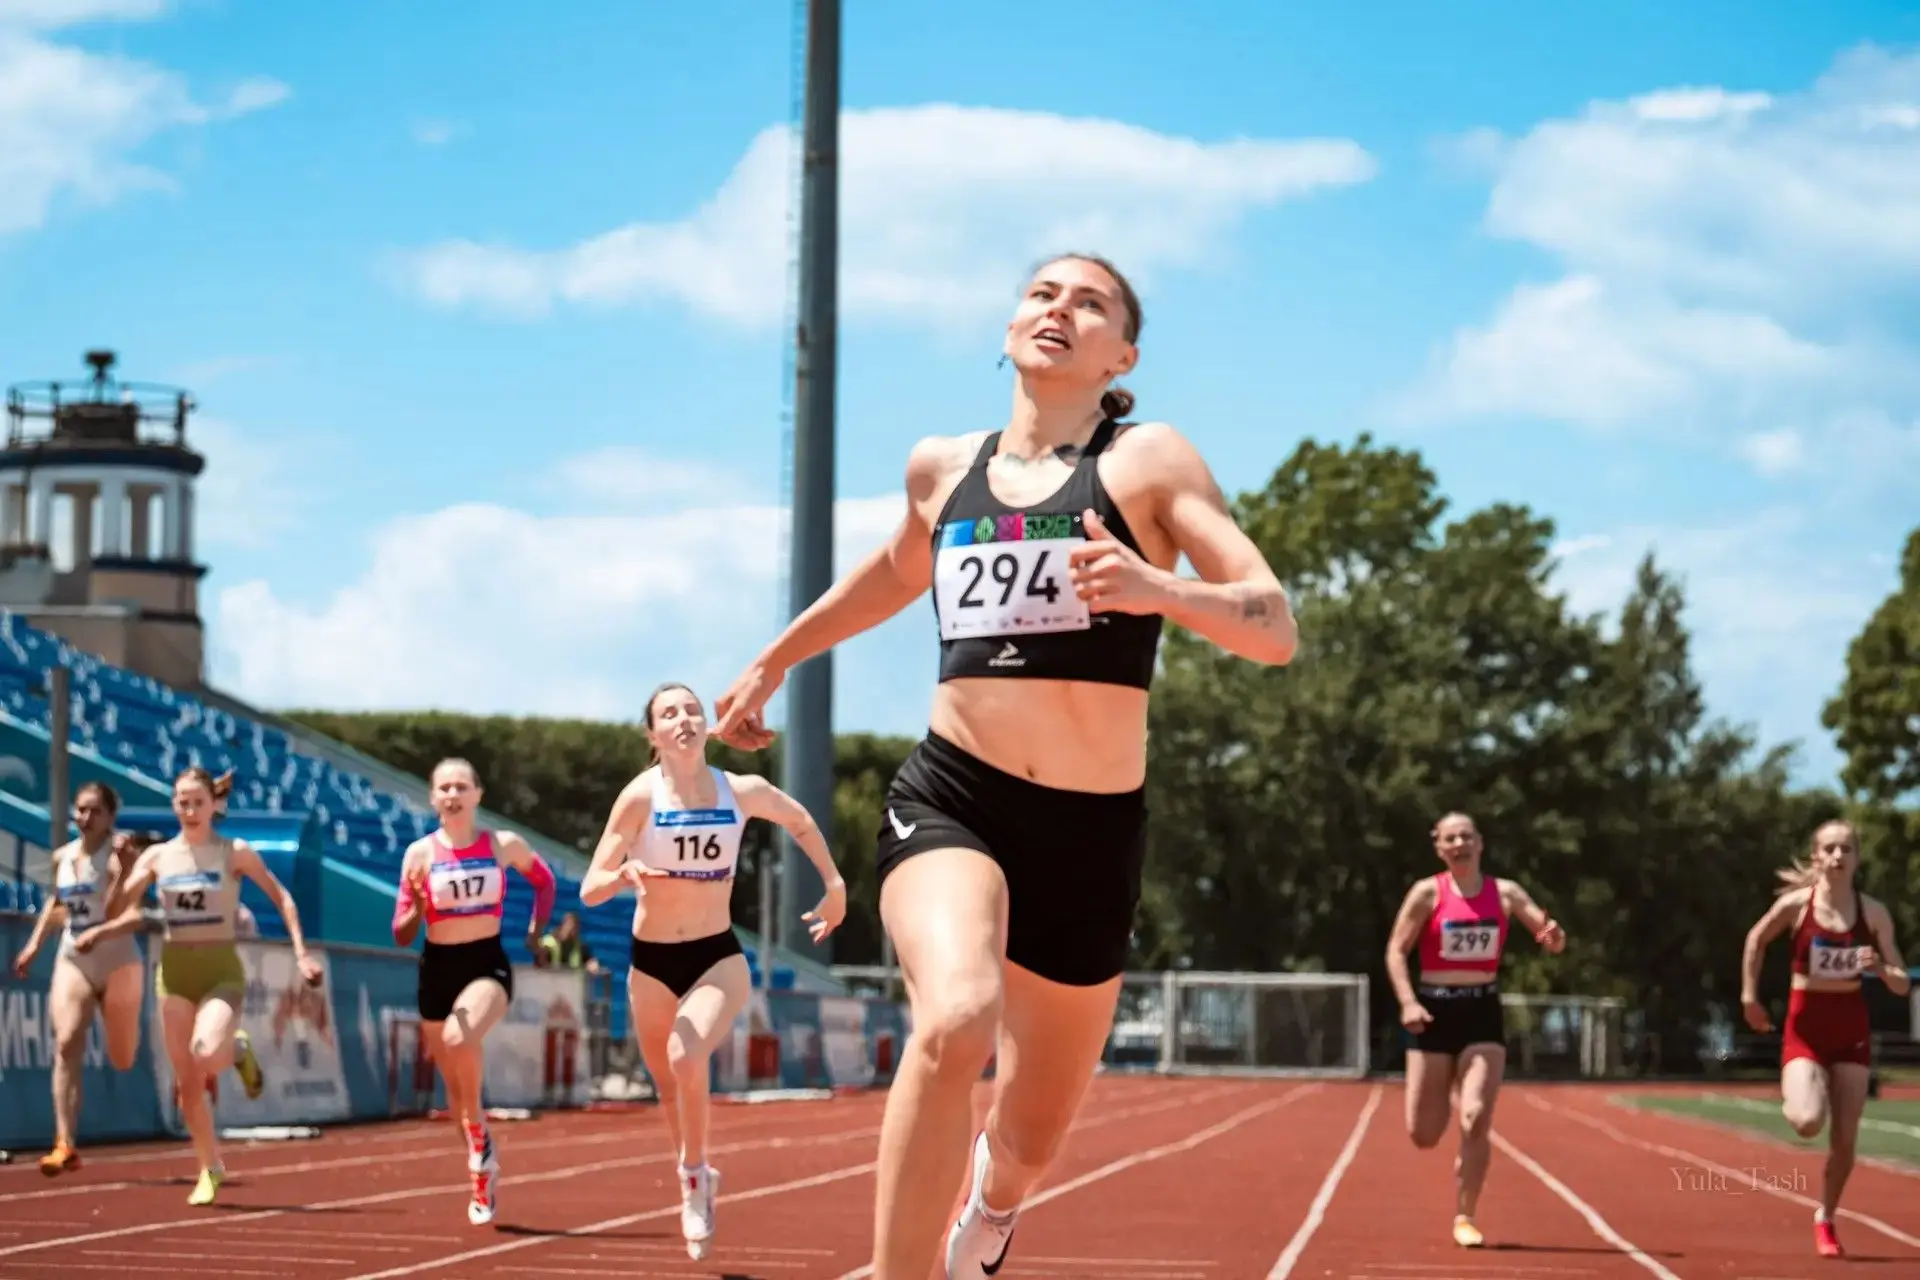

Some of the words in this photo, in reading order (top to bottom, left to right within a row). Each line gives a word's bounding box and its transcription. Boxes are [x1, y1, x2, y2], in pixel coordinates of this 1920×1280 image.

[958, 550, 1060, 608] 294
[673, 833, 721, 861] 116
[448, 876, 485, 900] 117
[176, 890, 206, 911] 42
[1450, 931, 1491, 952] 299
